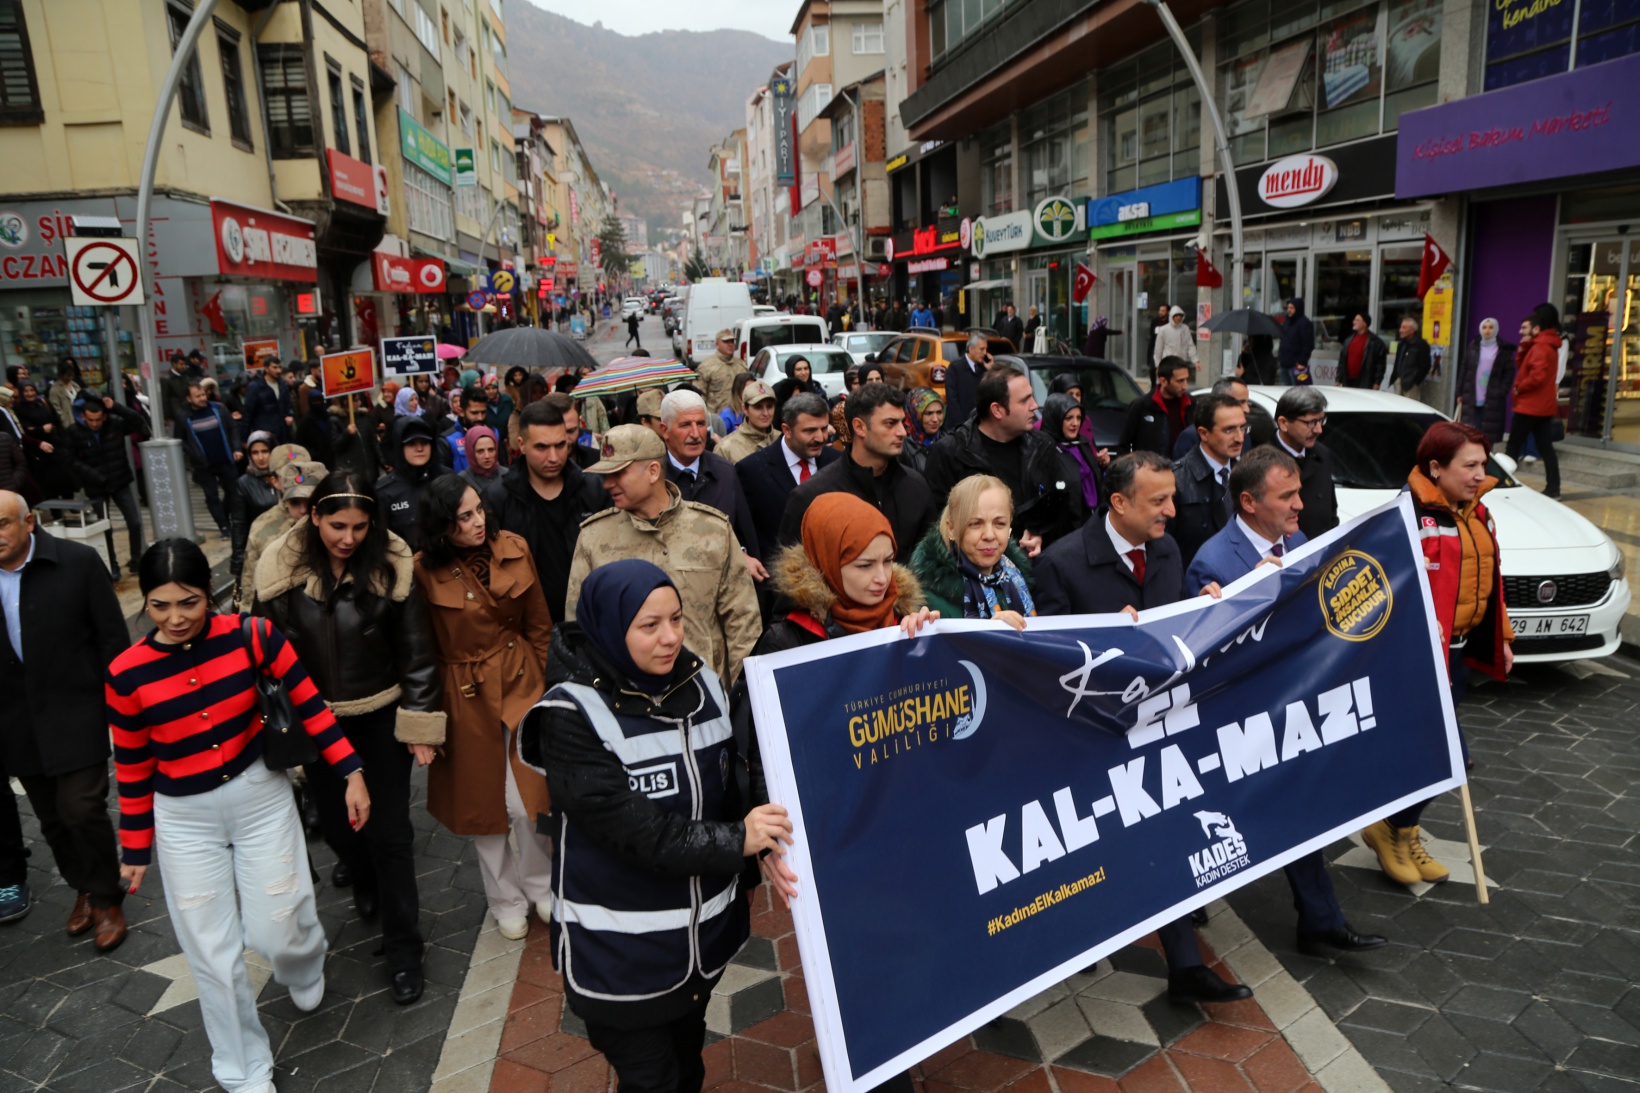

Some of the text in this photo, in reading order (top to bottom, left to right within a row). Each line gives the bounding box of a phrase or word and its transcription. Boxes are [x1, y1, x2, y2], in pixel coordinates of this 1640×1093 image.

[1413, 100, 1613, 162] Kişisel Bakım Marketi
[1265, 157, 1325, 199] mendy
[38, 209, 78, 247] ŞİF
[1117, 202, 1149, 222] aksa
[0, 254, 69, 280] CZAN
[297, 293, 315, 313] E
[1314, 364, 1340, 380] ORK
[1325, 556, 1356, 590] KADINA
[1336, 578, 1380, 623] İNSANLIK
[1339, 589, 1387, 633] SUÇUDUR
[1512, 618, 1585, 634] 29 AN 642
[845, 677, 949, 713] TÜRKİYE CUMHURİYETİ
[849, 684, 971, 747] GÜMÜŞHANE
[1127, 682, 1200, 749] EL
[853, 722, 950, 770] VALİLİĞİ
[628, 772, 669, 792] OLİS
[965, 676, 1377, 896] KAL-KA-MAZ!
[1188, 833, 1247, 877] KADES
[1195, 854, 1250, 888] KADIN DESTEK
[987, 866, 1106, 936] #KadınaElKalkamaz!
